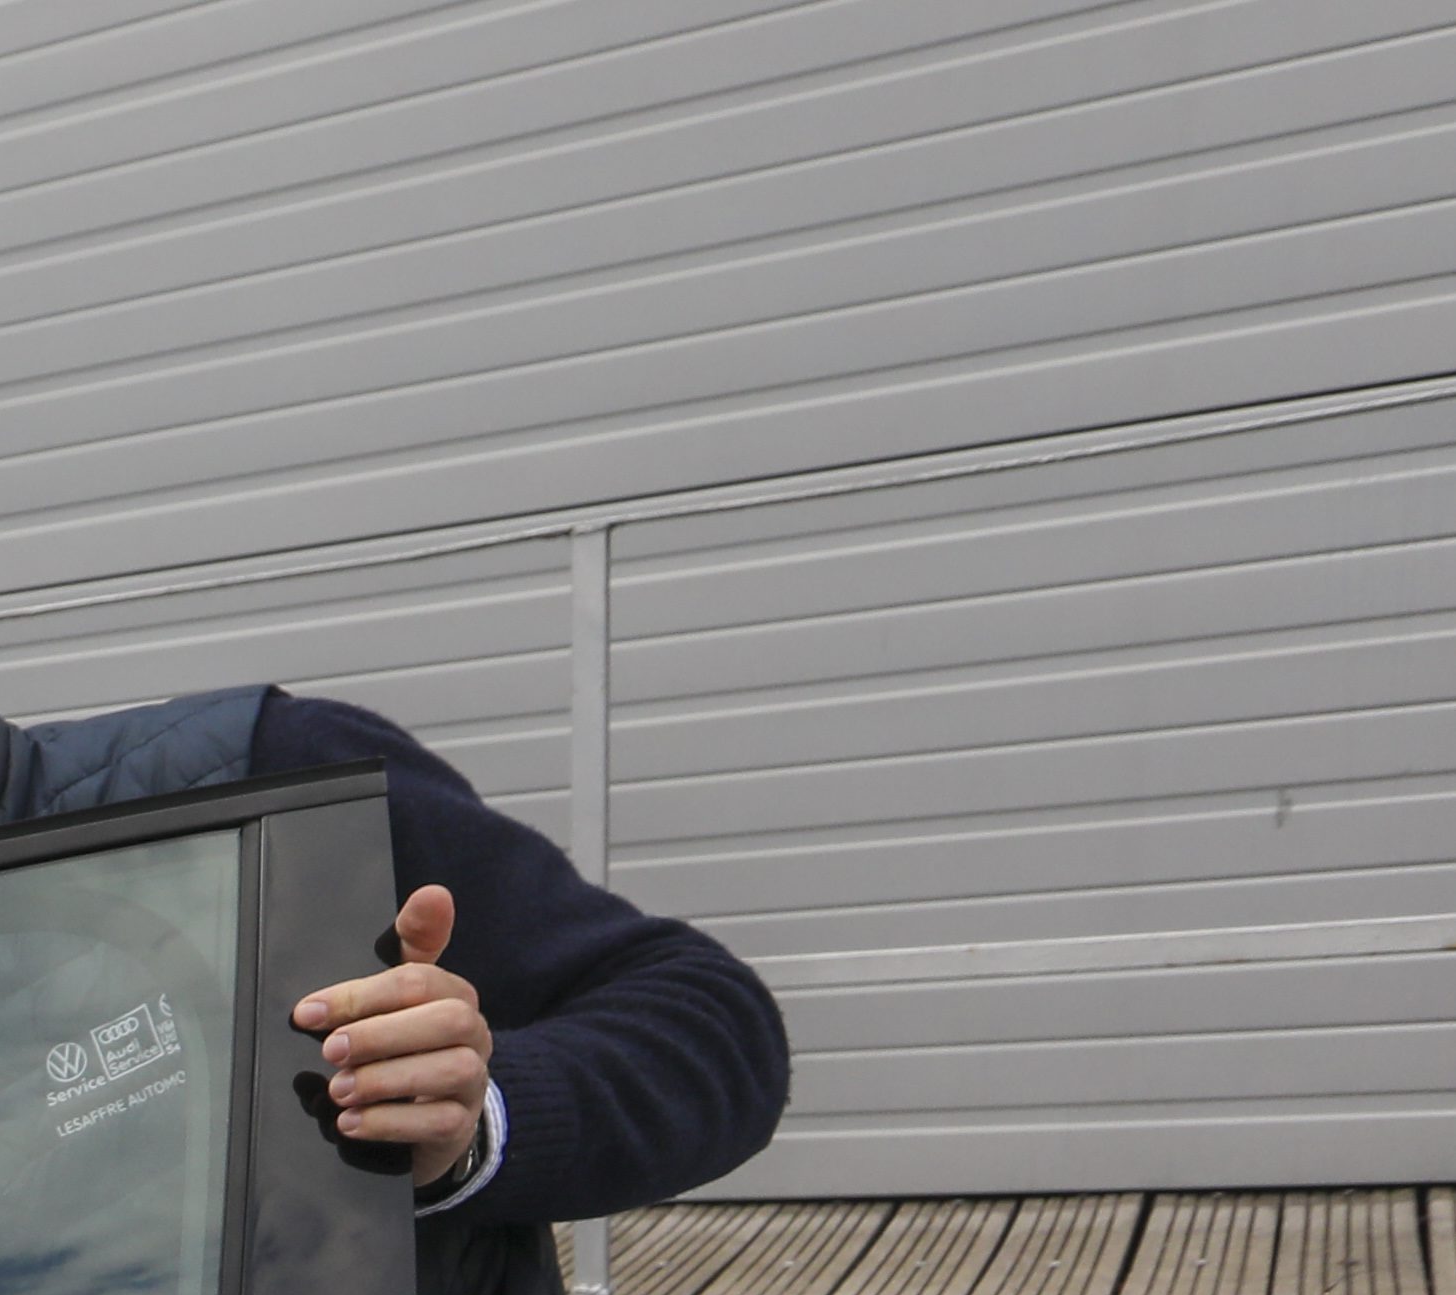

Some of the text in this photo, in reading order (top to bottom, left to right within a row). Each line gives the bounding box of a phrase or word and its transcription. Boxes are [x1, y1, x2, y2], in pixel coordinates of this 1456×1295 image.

[106, 1038, 141, 1063] Audi
[108, 1045, 160, 1076] Service
[46, 1075, 107, 1106] Service
[56, 1099, 127, 1137] LESAFFRE
